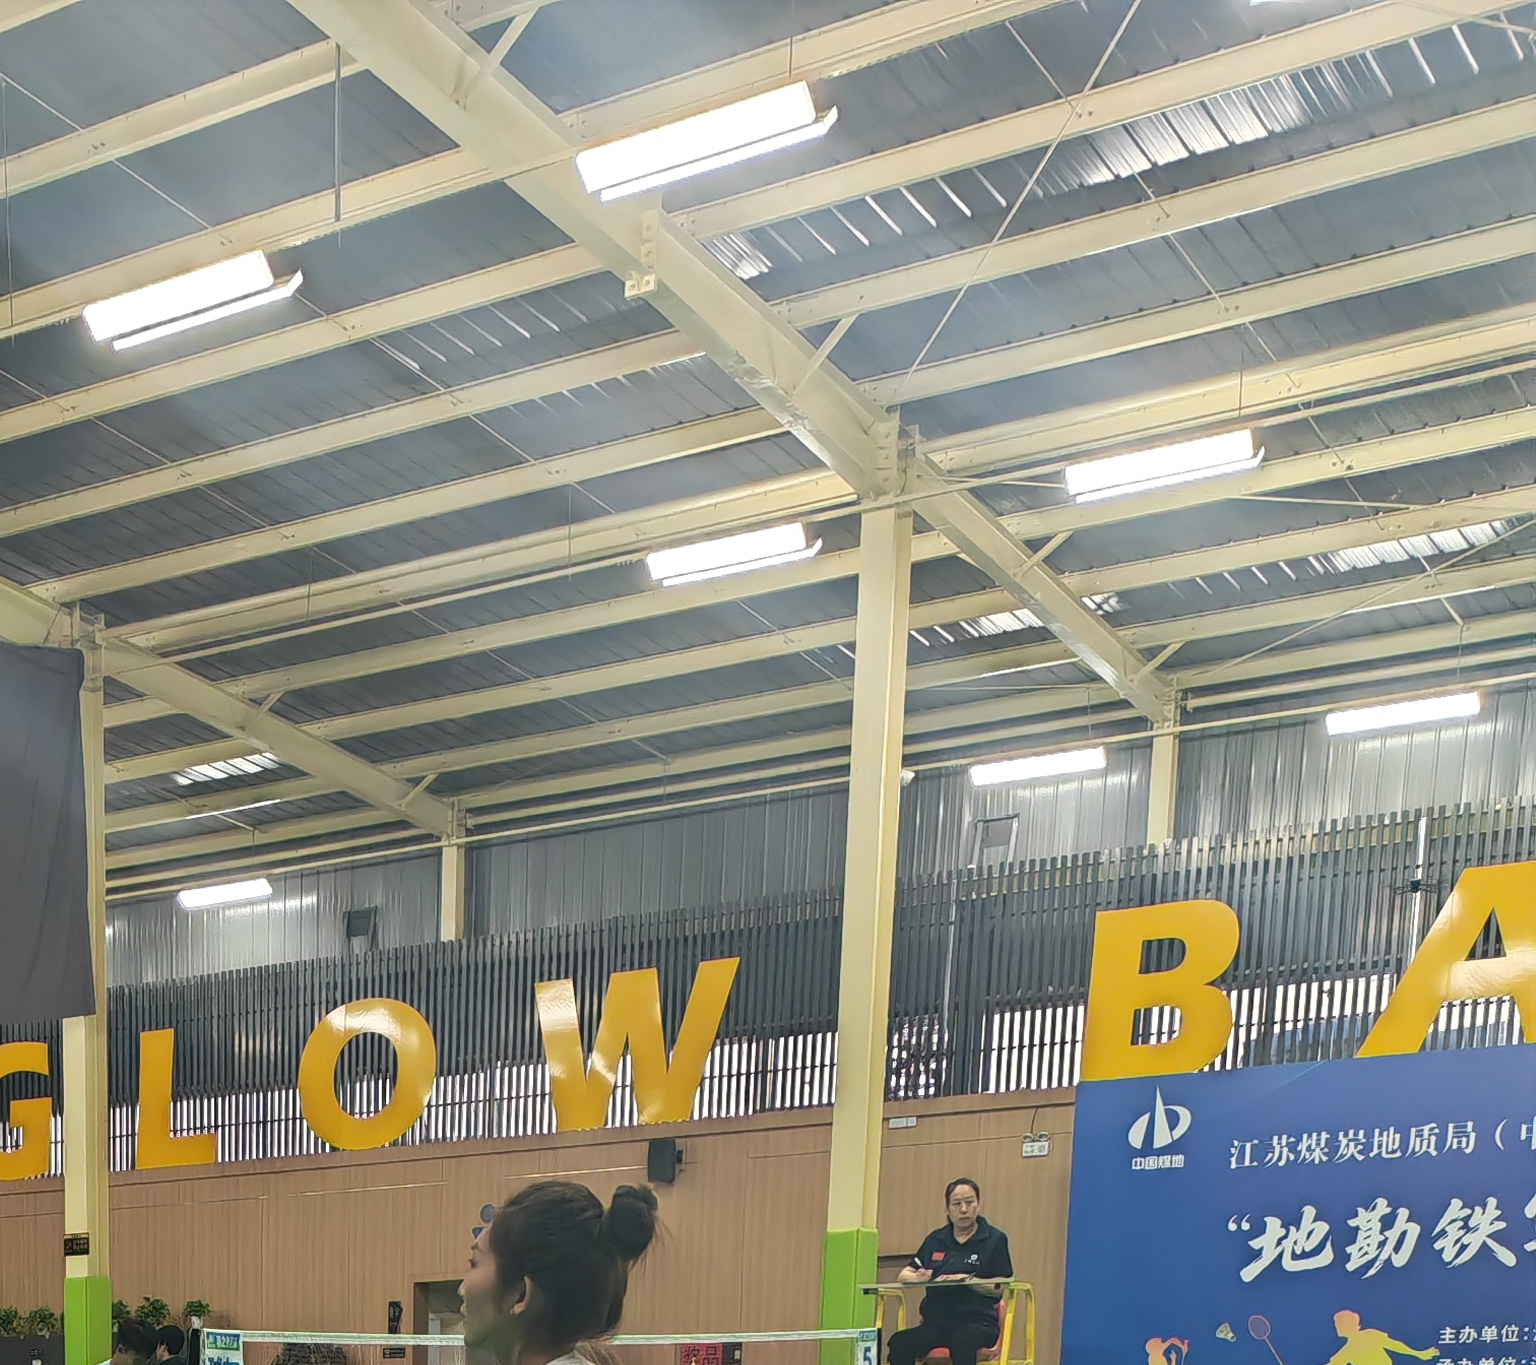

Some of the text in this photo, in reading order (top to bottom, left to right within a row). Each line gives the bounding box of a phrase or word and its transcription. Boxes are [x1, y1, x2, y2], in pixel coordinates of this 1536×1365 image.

[1227, 1194, 1536, 1283] “地勘铁
[1438, 1324, 1536, 1344] 主办单位：
